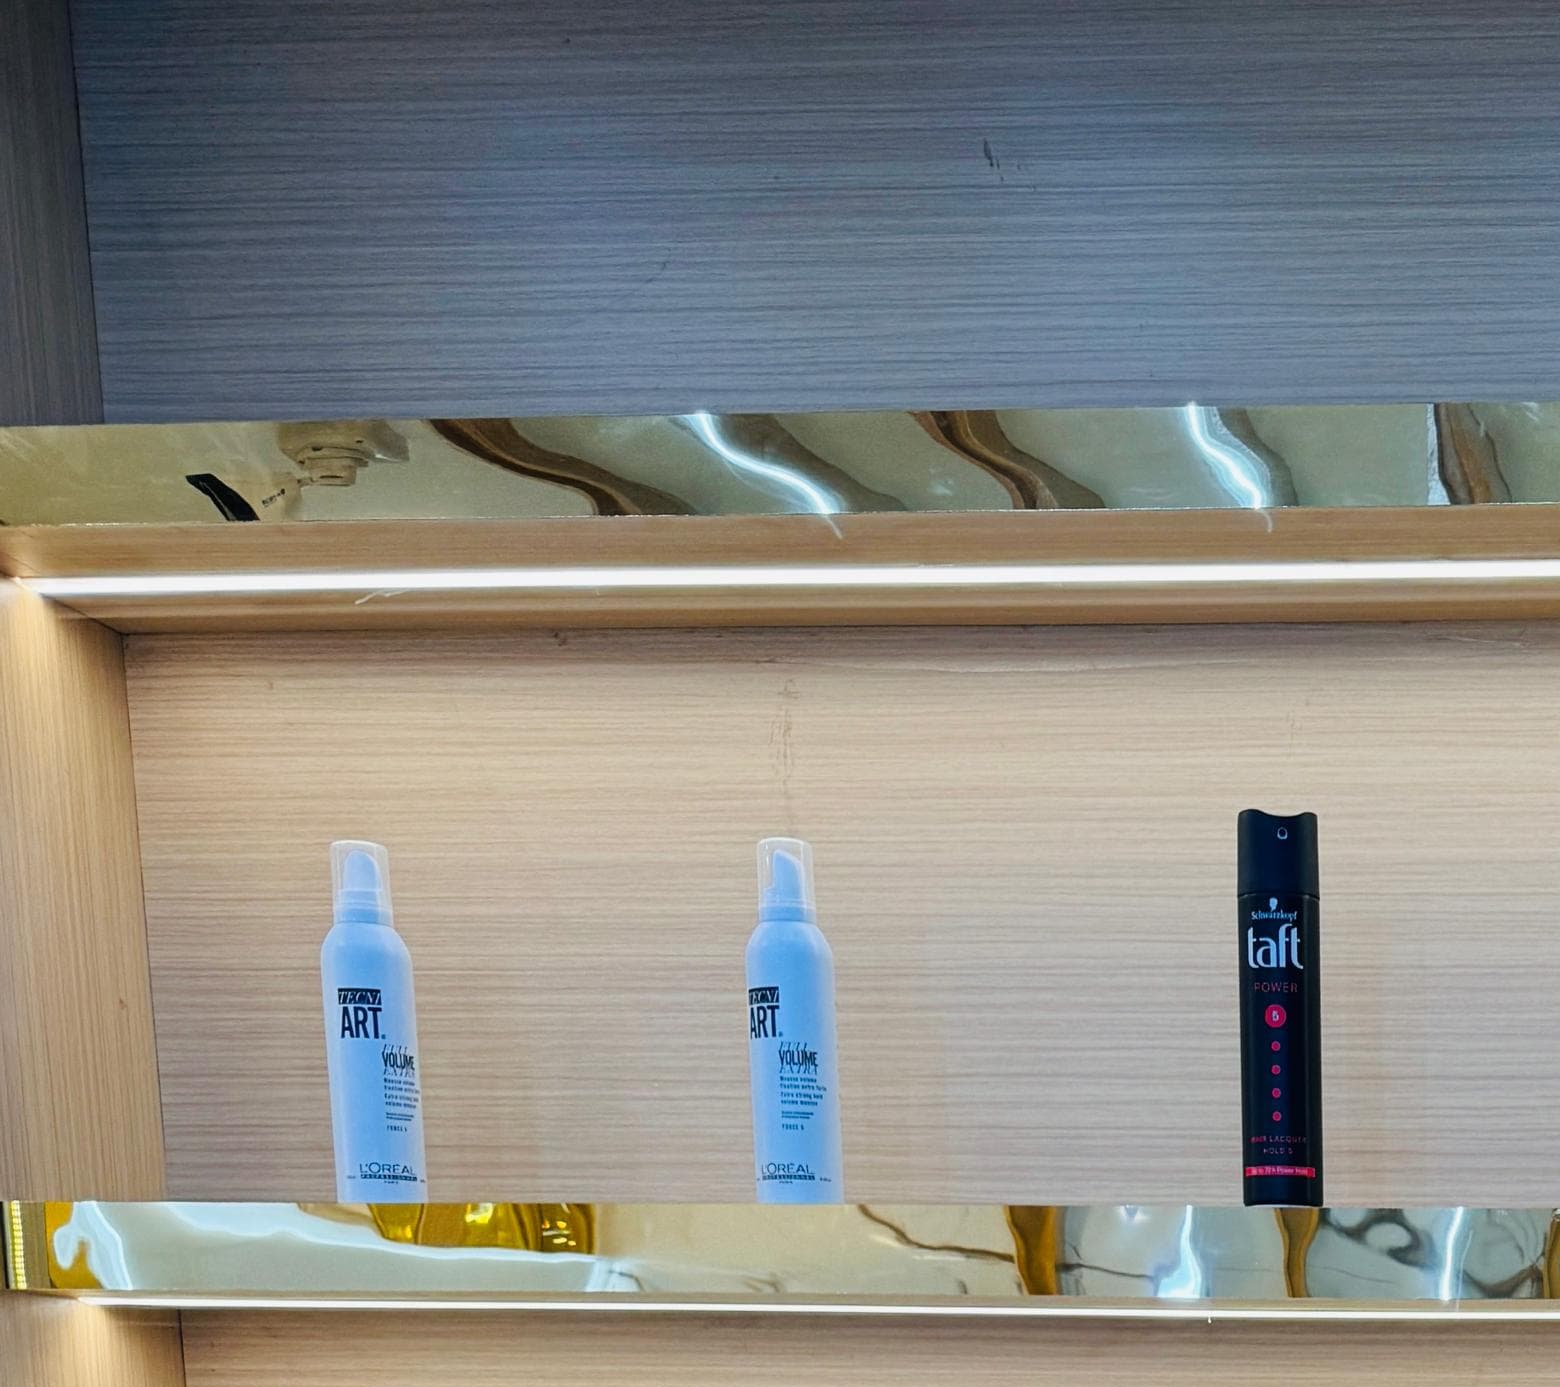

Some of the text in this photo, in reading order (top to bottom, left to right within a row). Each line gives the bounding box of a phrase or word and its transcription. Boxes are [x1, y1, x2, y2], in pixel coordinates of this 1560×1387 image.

[1247, 923, 1304, 970] taft
[382, 1050, 415, 1071] VOLUME
[779, 1049, 819, 1069] VOLUME
